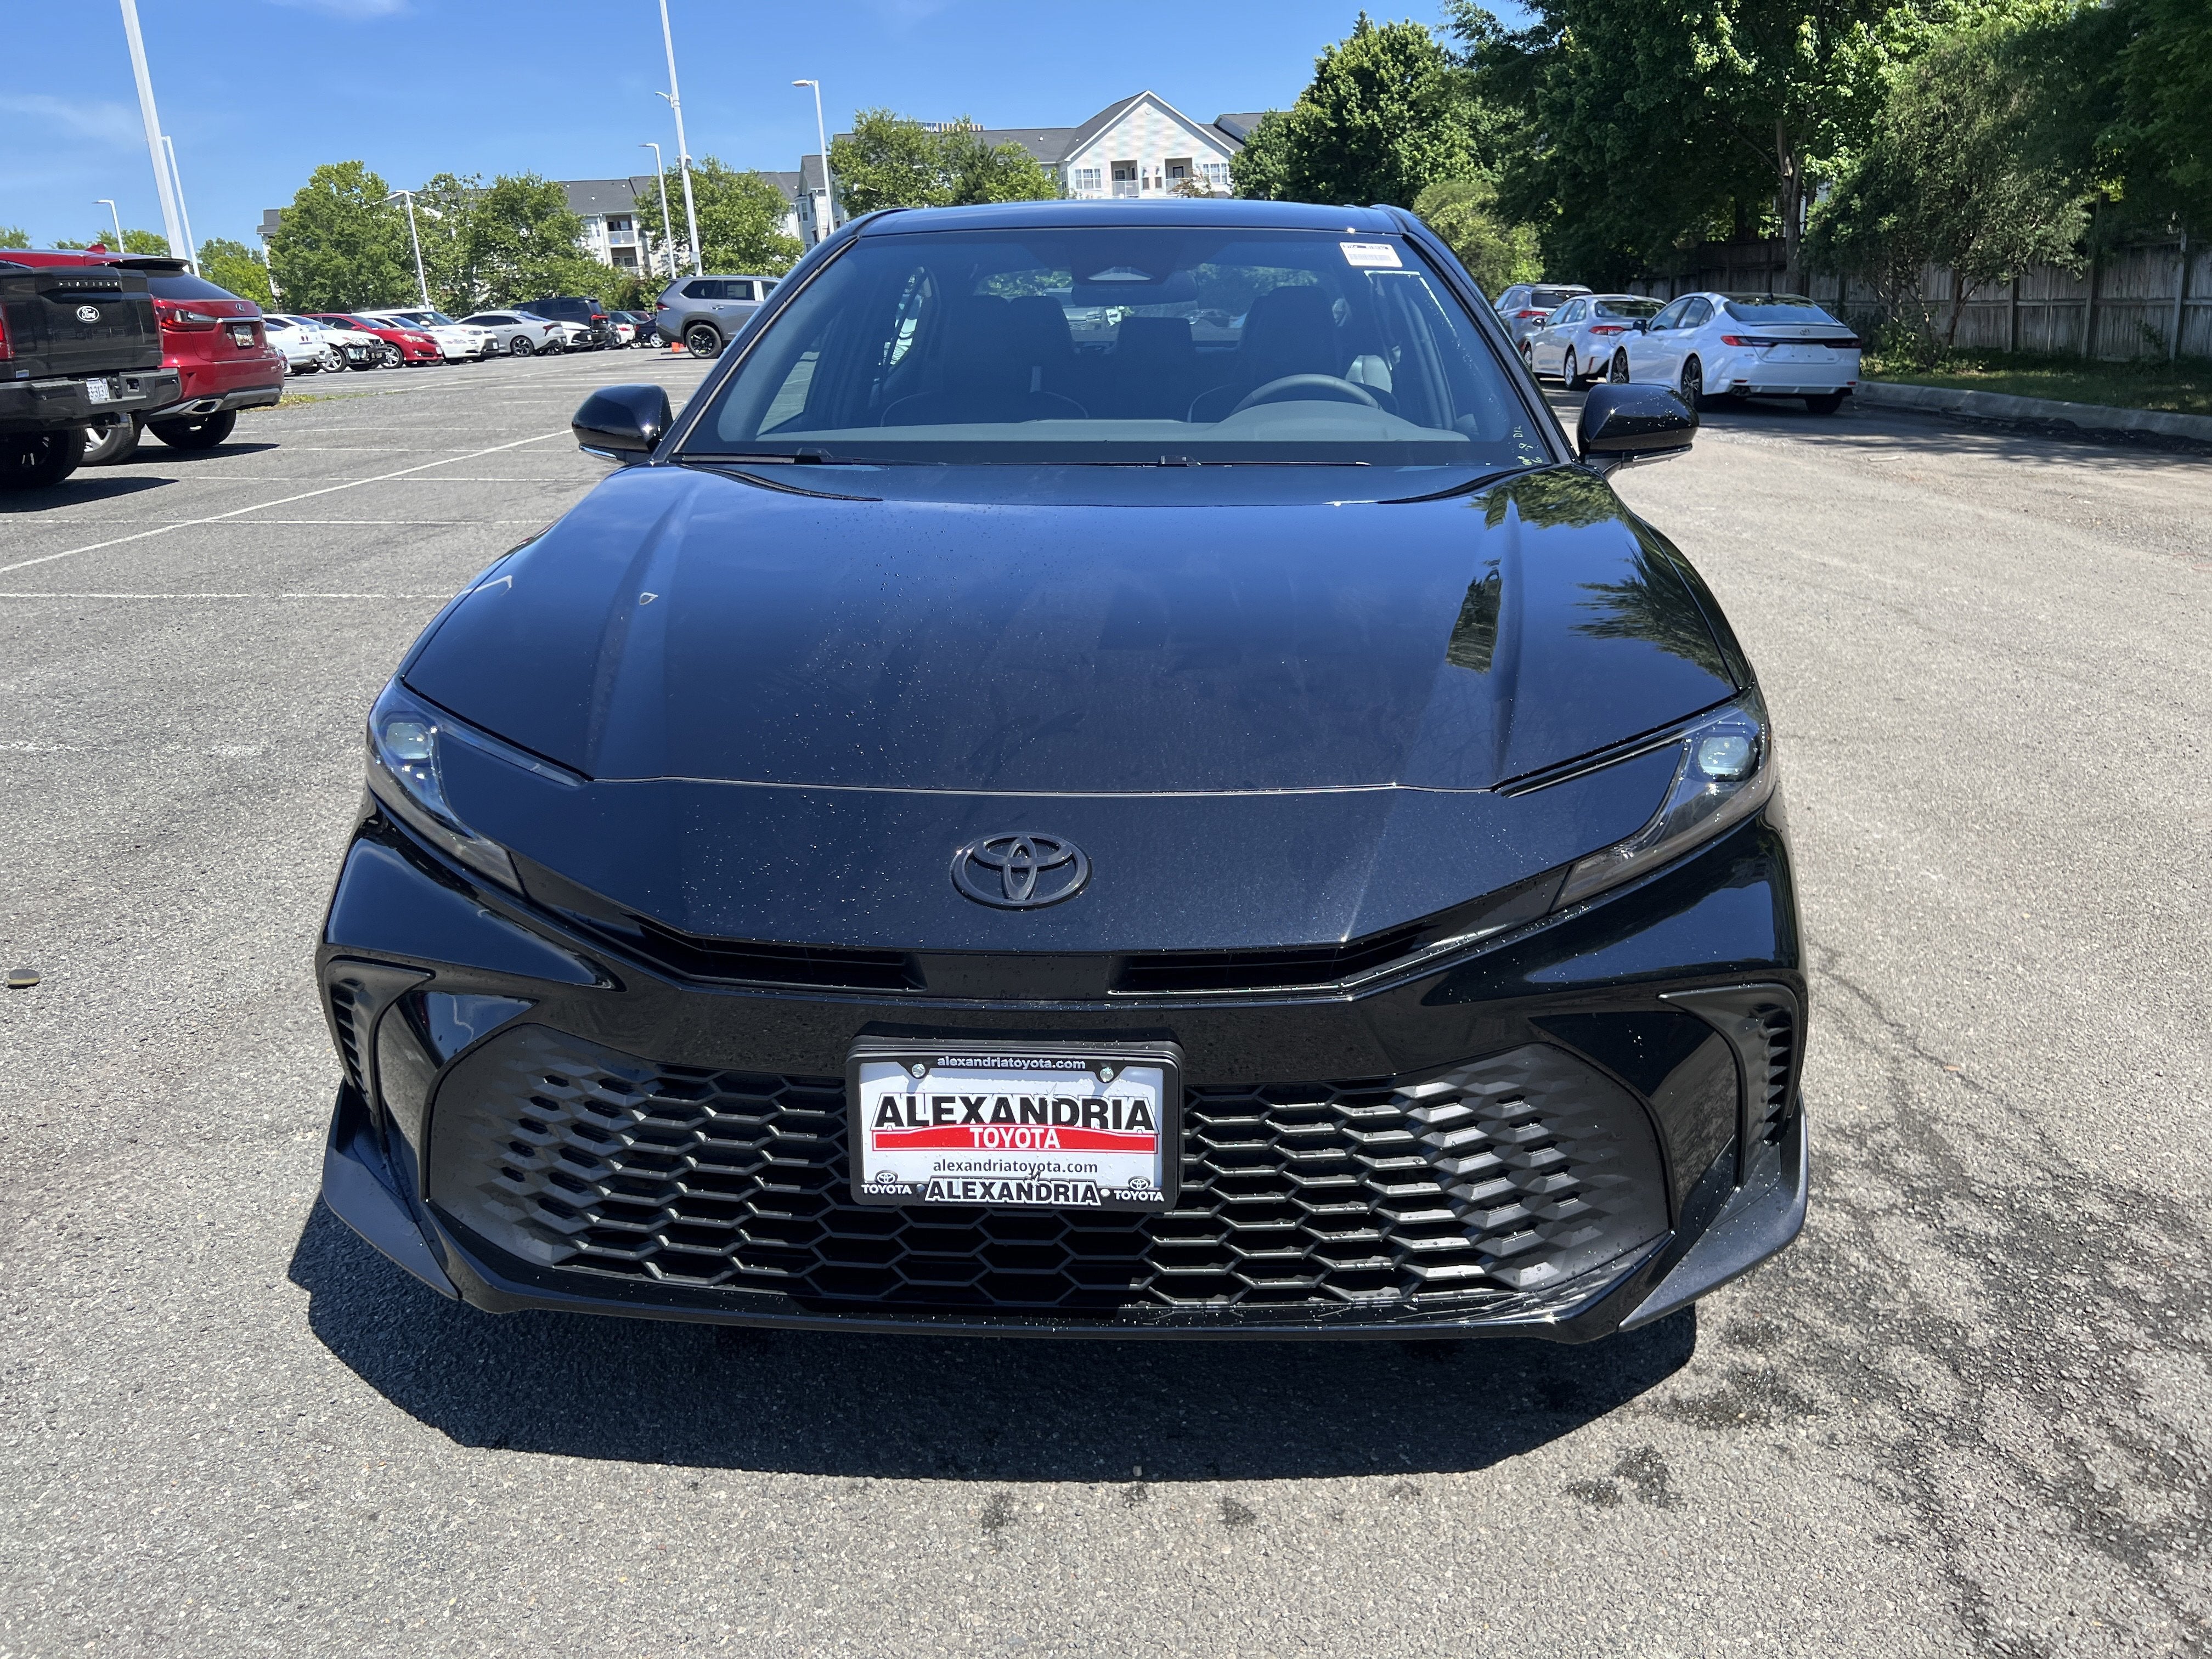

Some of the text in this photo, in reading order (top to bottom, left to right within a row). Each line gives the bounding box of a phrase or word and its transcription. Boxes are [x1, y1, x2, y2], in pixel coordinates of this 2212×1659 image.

[81, 307, 97, 319] Ford
[937, 1056, 1086, 1069] alexandriatoyota.com
[874, 1096, 1156, 1131] ALEXANDRIA
[969, 1127, 1061, 1149] TOYOTA
[933, 1159, 1098, 1175] alexandriatoyota.com
[861, 1183, 912, 1195] TOYOTA
[927, 1177, 1099, 1204] ALEXANDRIA
[1113, 1189, 1165, 1202] TOYOTA
